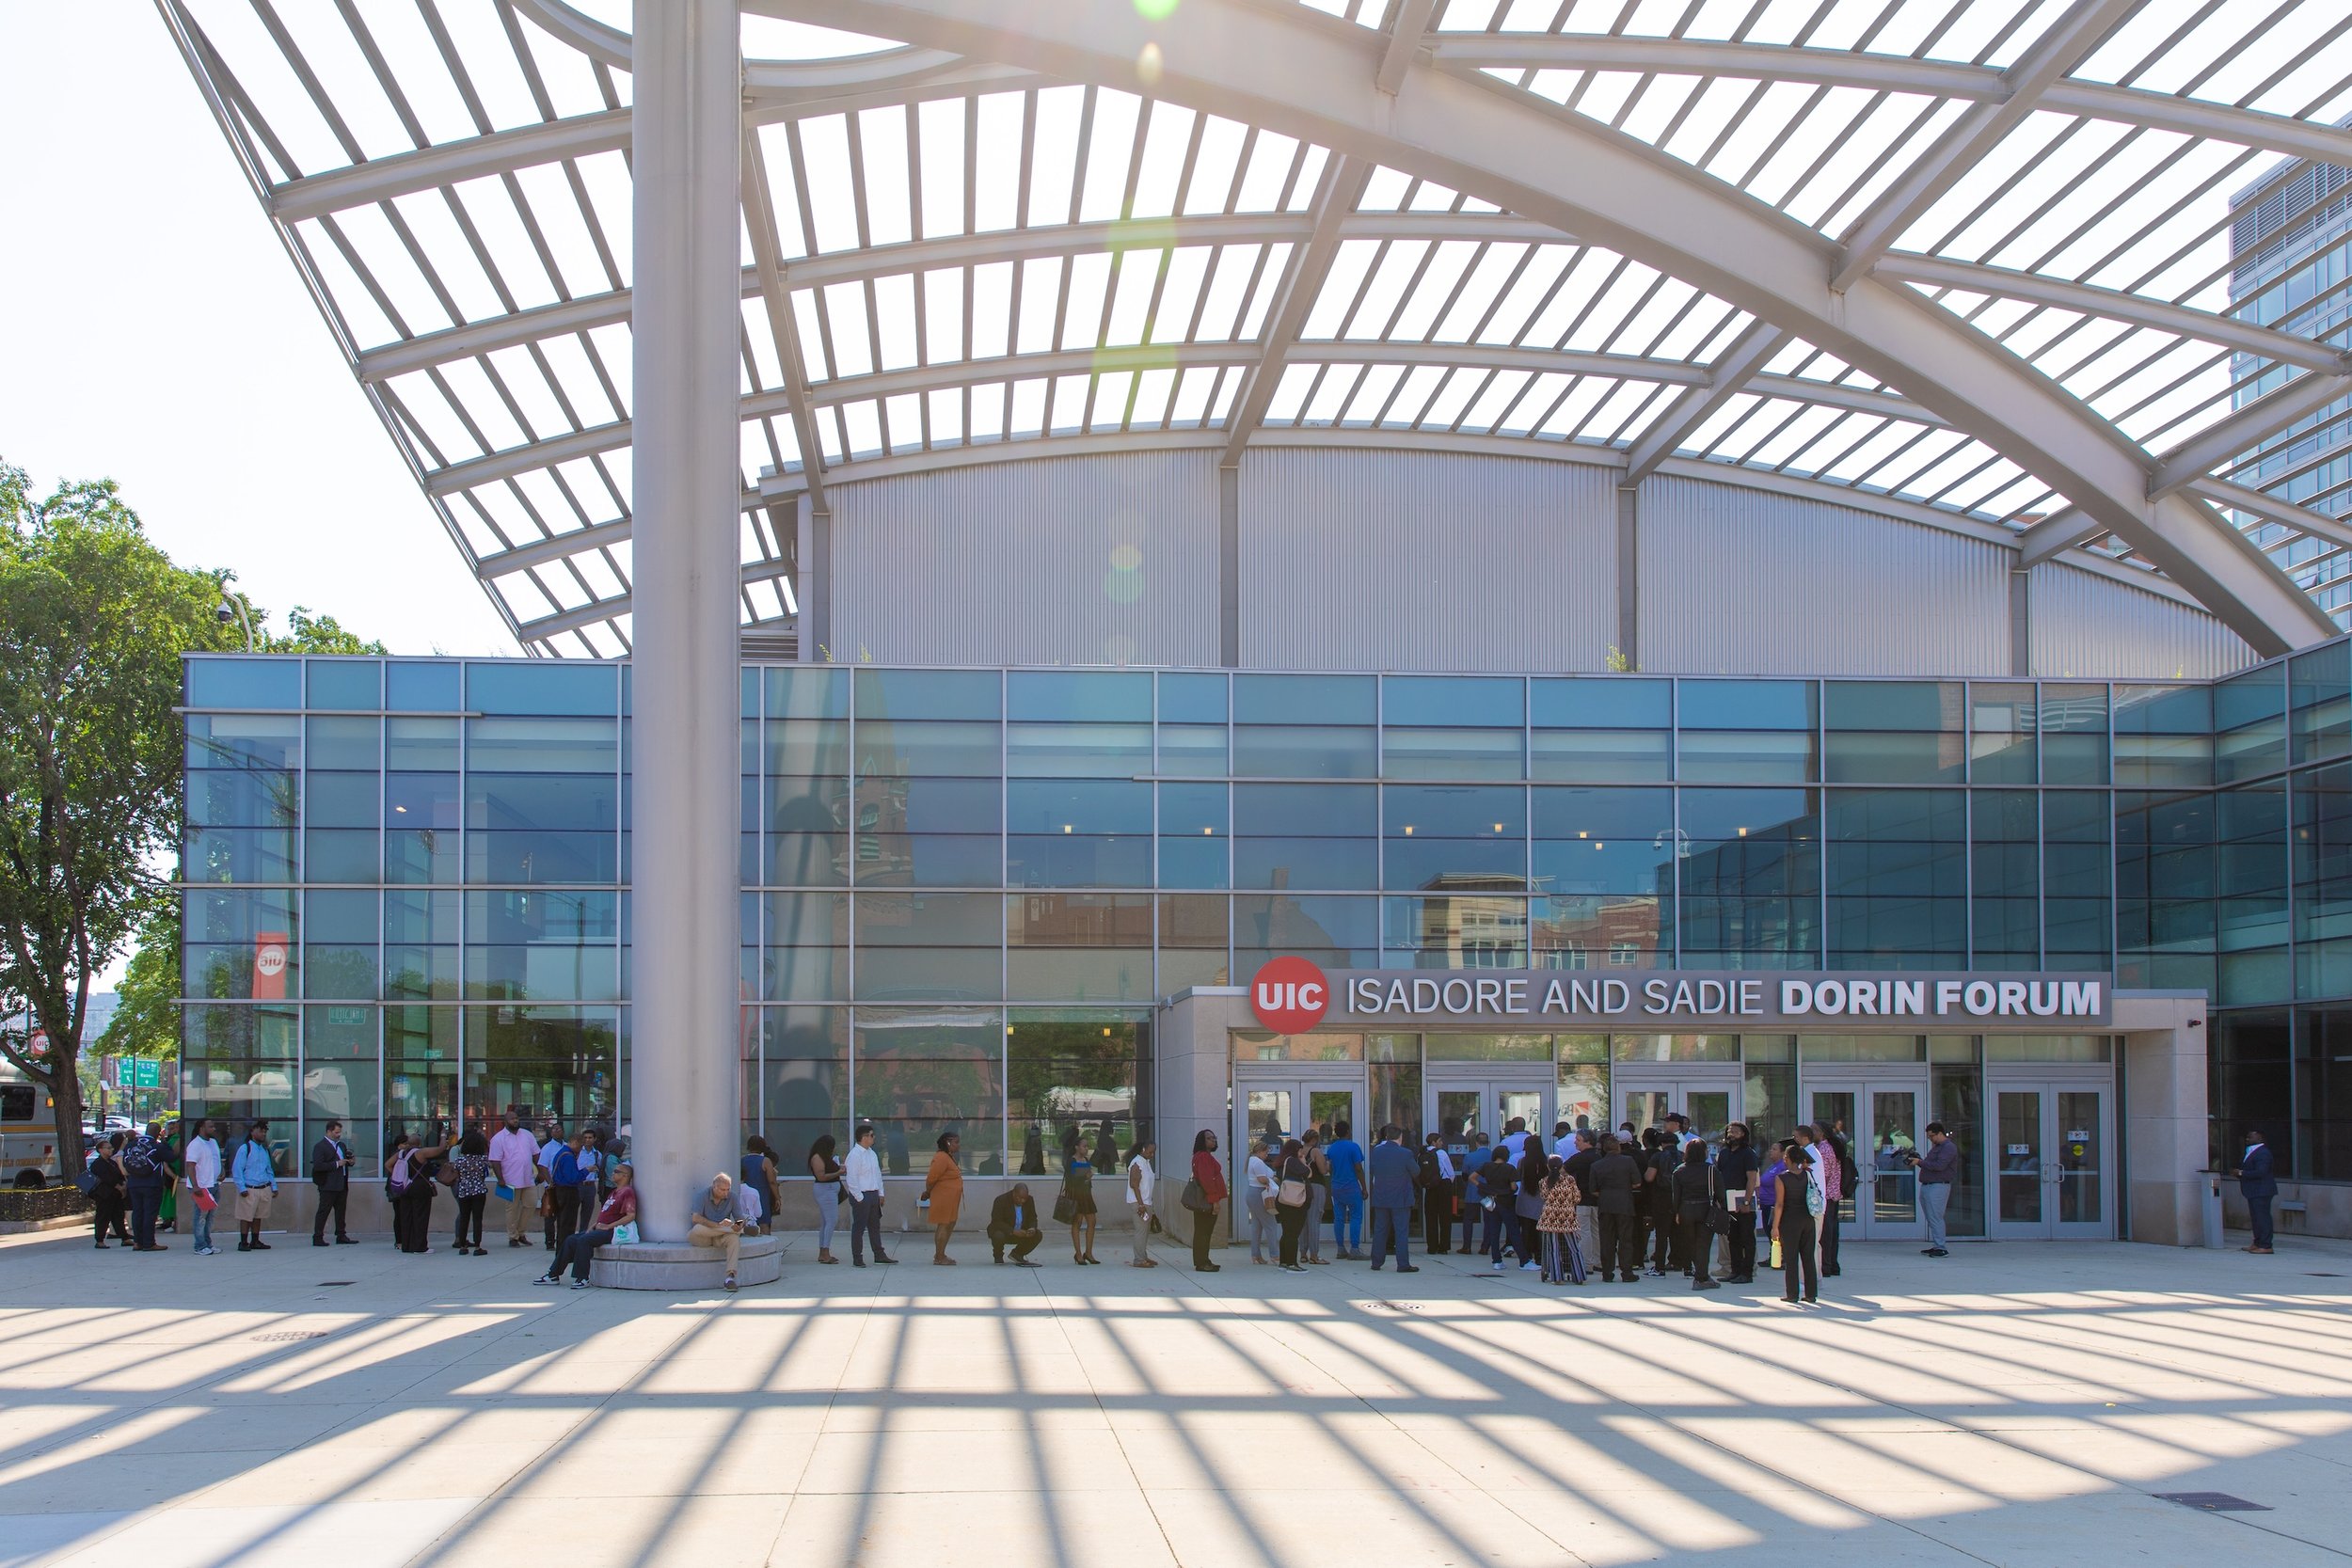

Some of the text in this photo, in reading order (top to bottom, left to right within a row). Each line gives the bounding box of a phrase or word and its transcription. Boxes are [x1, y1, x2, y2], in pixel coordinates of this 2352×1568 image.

[1258, 983, 1323, 1011] UIC
[1347, 978, 2101, 1016] ISADORE AND SADIE DORIN FORUM
